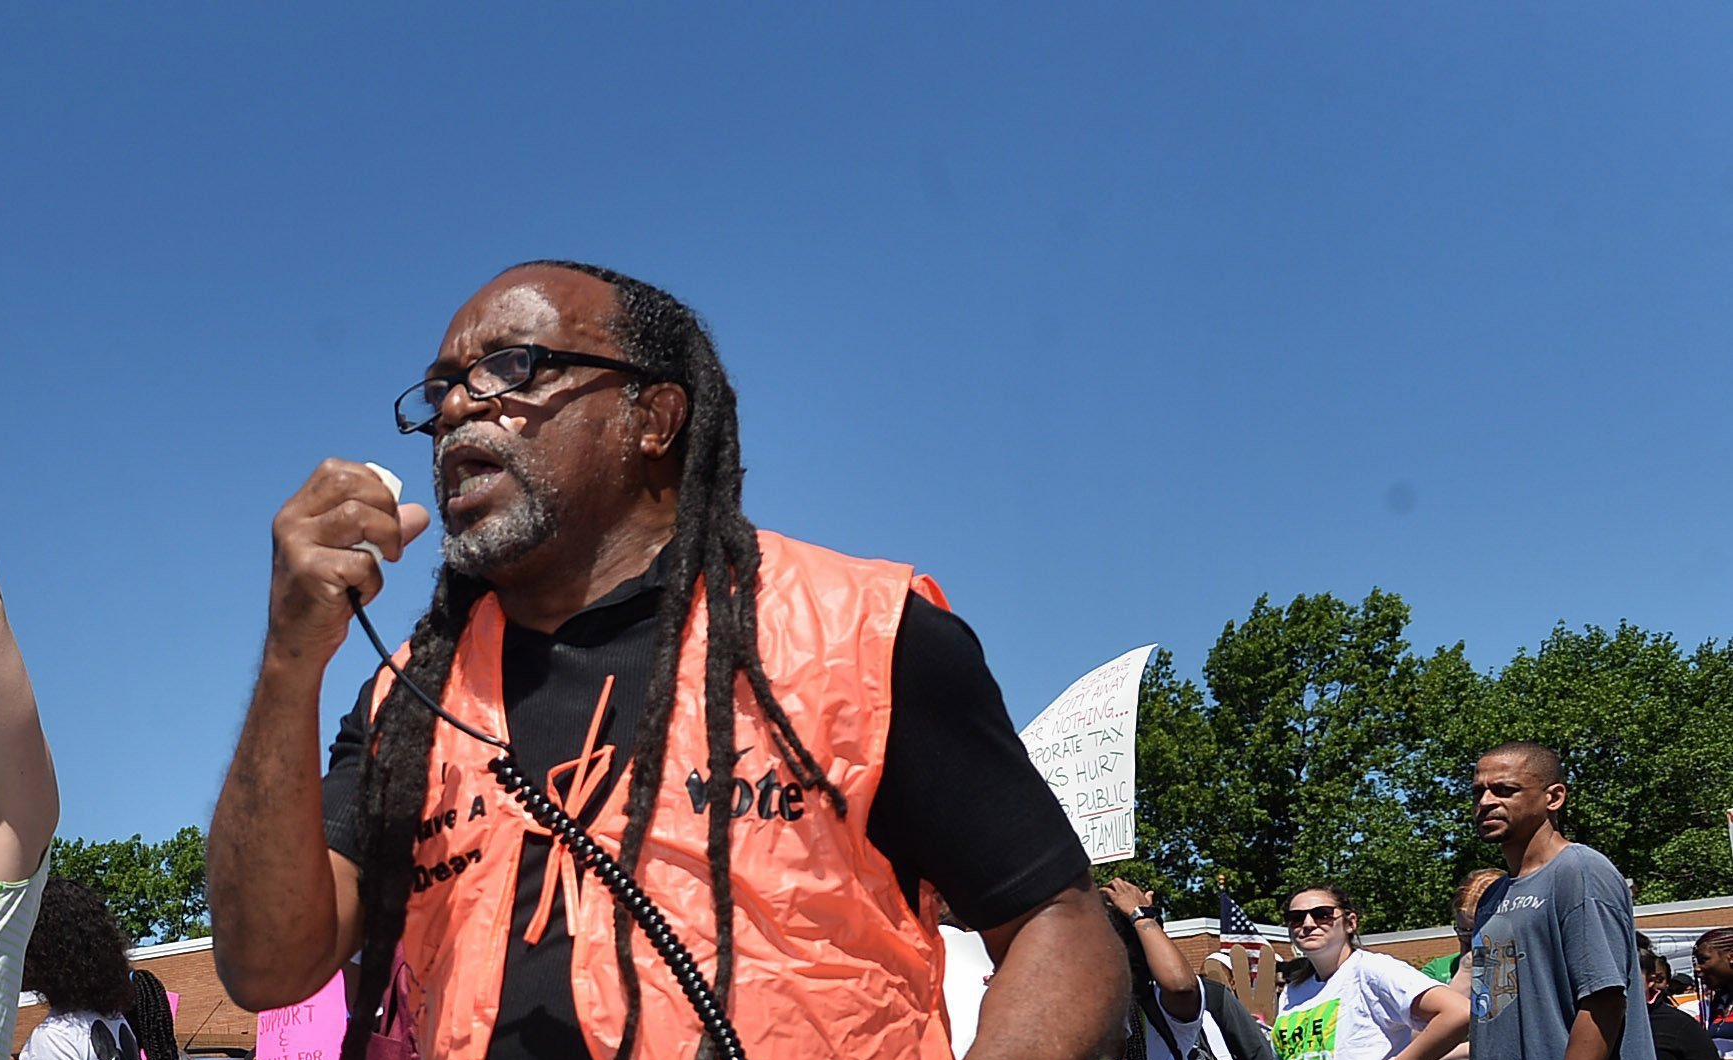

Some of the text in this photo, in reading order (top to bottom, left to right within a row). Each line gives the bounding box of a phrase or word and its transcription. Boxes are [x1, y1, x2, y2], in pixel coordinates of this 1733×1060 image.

[1087, 721, 1124, 748] TAX
[1044, 751, 1125, 788] KS HURT
[467, 794, 488, 823] A
[1076, 780, 1129, 815] PUBLIC
[1509, 895, 1546, 912] SHOW
[259, 1004, 315, 1036] SUPPORT
